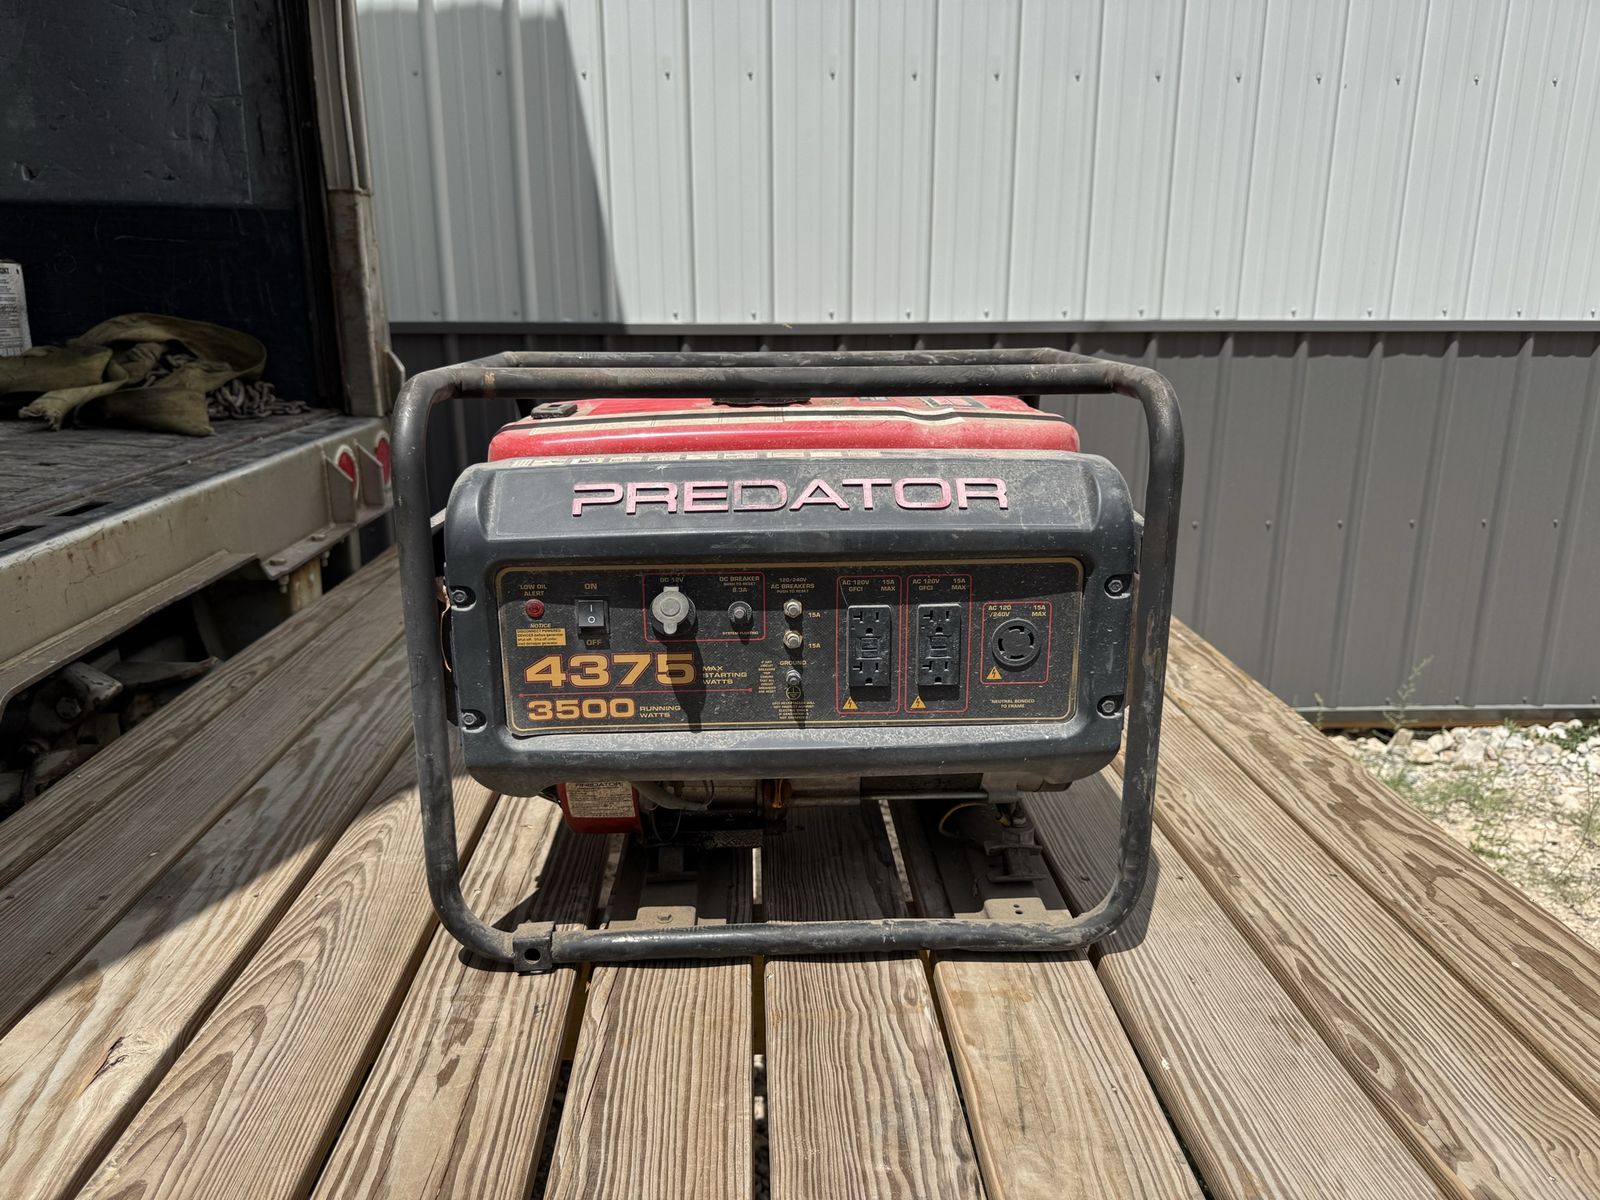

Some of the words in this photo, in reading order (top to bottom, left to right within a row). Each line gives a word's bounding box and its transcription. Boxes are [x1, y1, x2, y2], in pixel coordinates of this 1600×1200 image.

[571, 477, 1009, 517] PREDATOR
[524, 652, 697, 688] 4375
[527, 697, 636, 721] 3500
